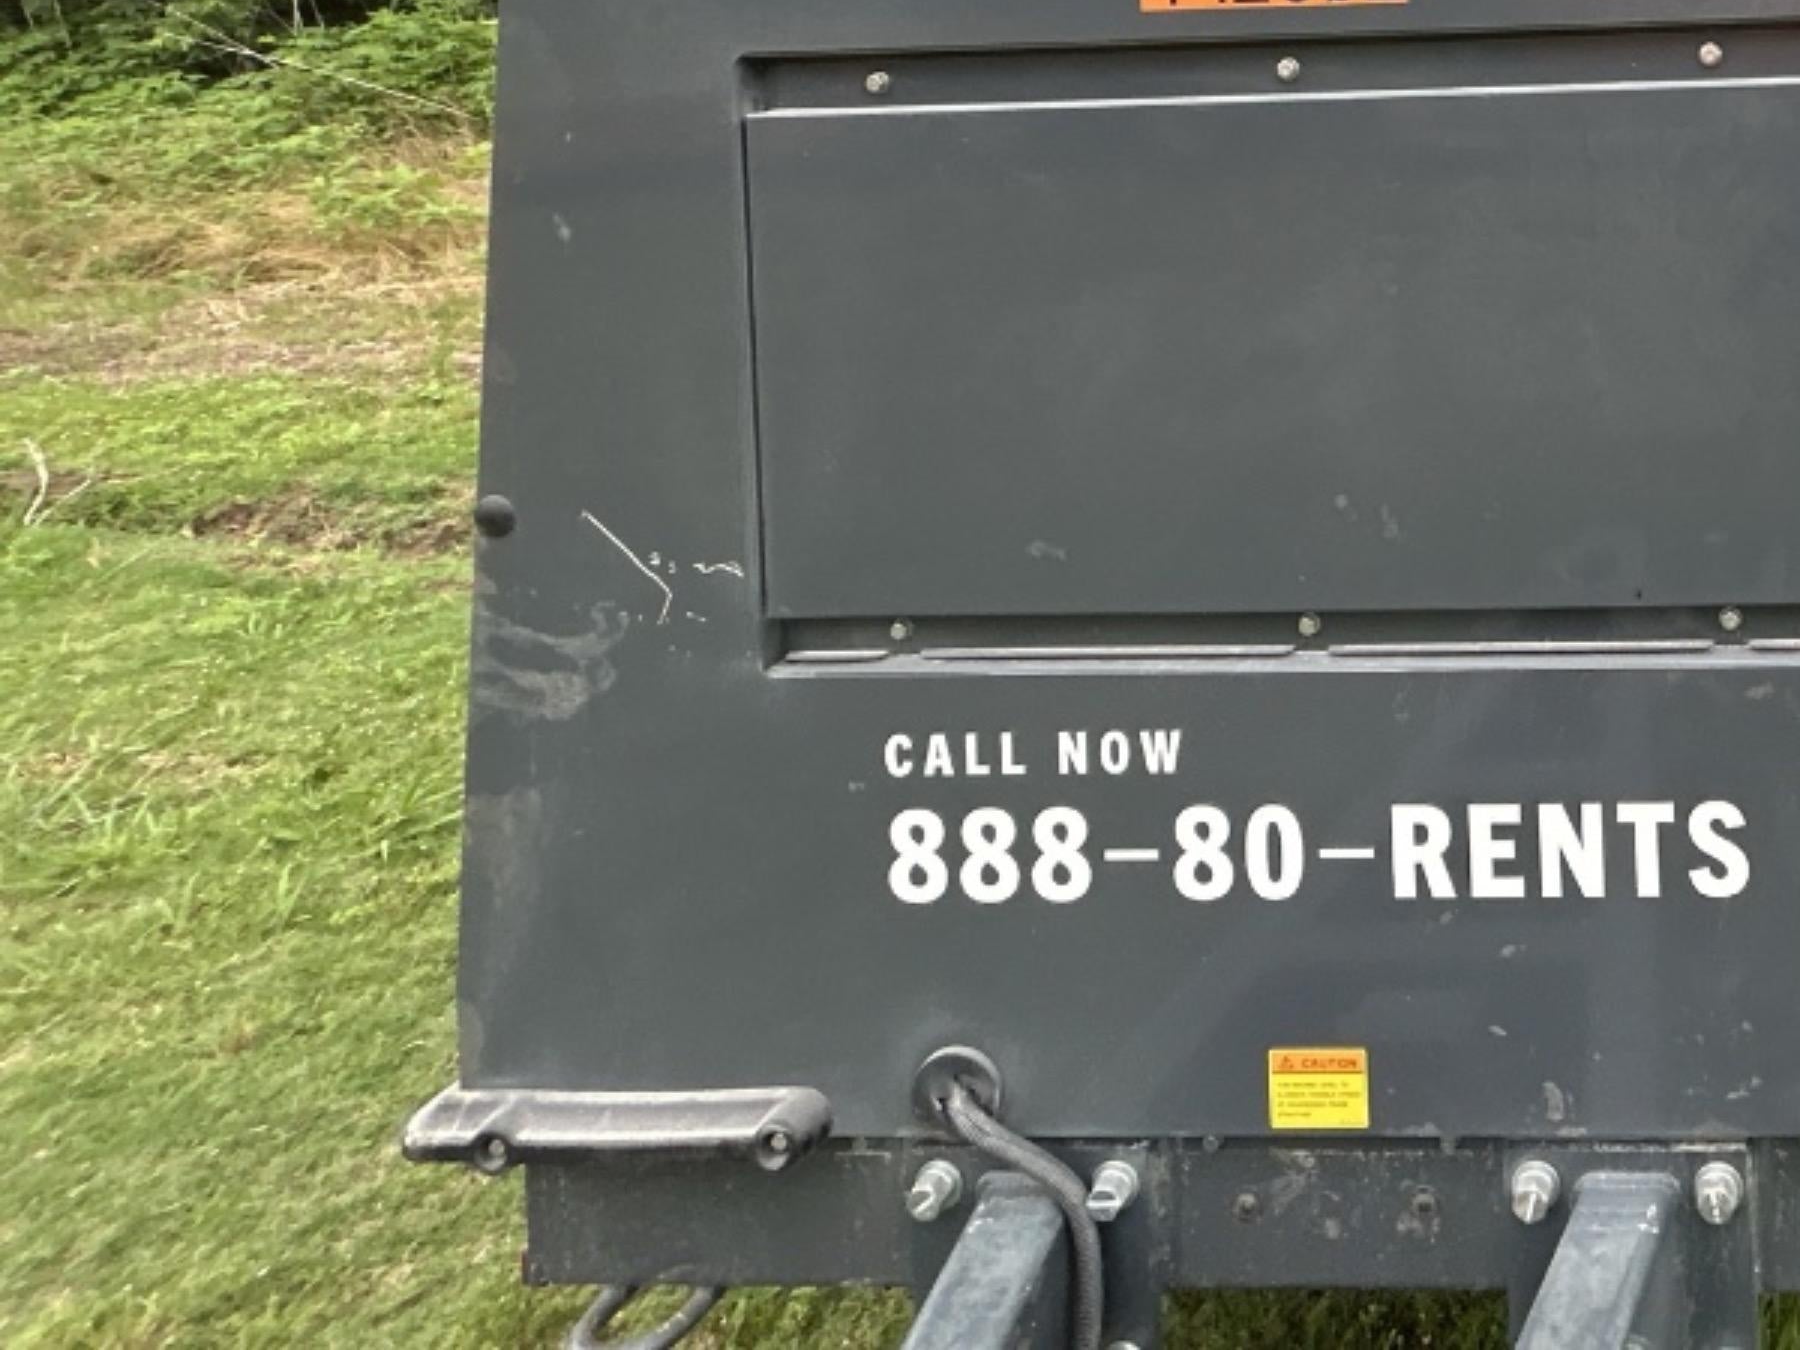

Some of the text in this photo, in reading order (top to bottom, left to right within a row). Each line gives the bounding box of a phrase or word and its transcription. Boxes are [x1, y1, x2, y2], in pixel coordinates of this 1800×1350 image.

[884, 729, 1182, 777] CALL NOW
[887, 800, 1751, 904] 888-80-RENTS
[1301, 1057, 1358, 1069] CAUTION
